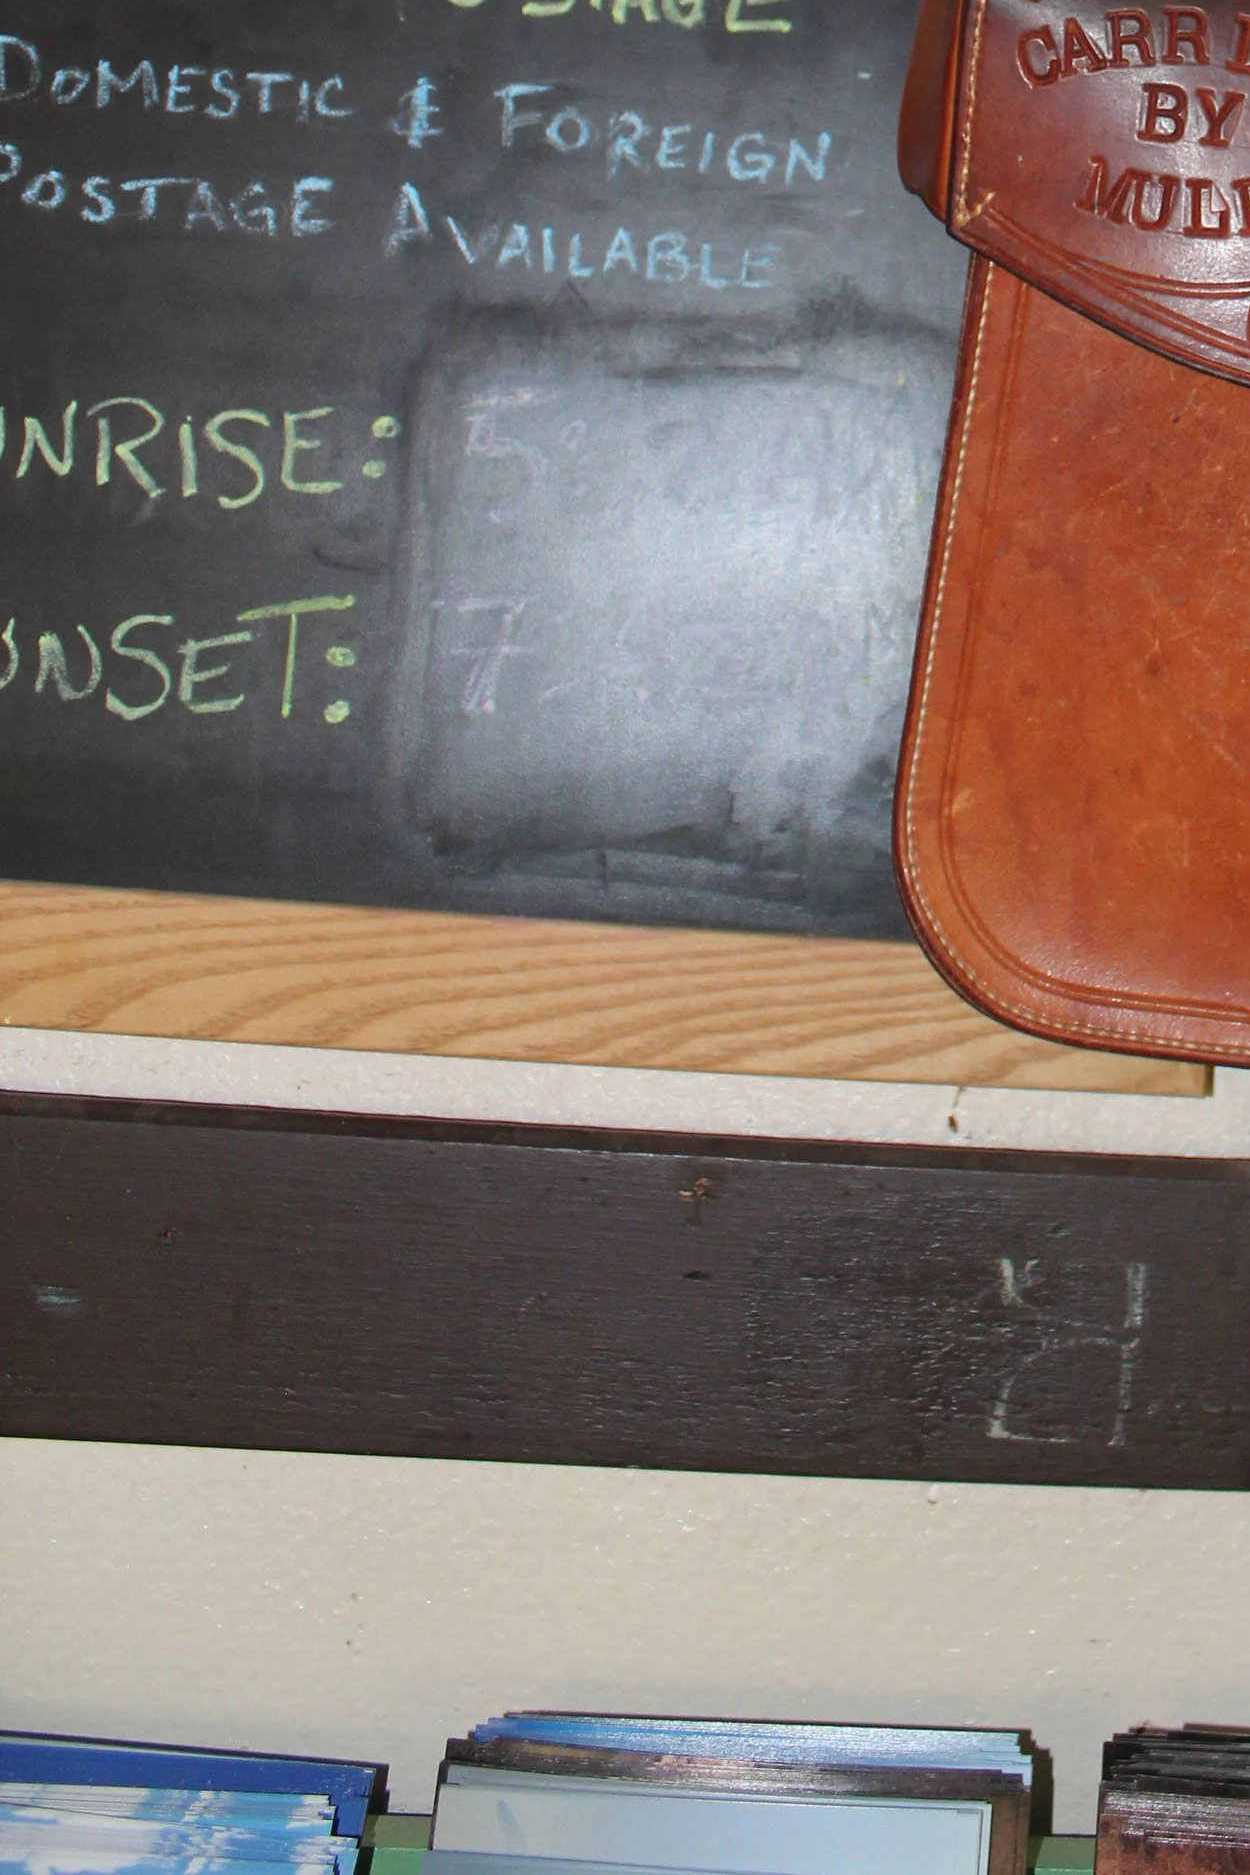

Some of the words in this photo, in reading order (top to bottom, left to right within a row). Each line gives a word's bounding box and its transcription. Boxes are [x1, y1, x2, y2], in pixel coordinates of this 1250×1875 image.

[0, 34, 354, 120] DOMESTIC
[492, 81, 833, 186] FOREIGN
[1135, 80, 1249, 150] BY
[382, 181, 784, 290] AVAILABLE
[0, 395, 401, 510] NRISE:
